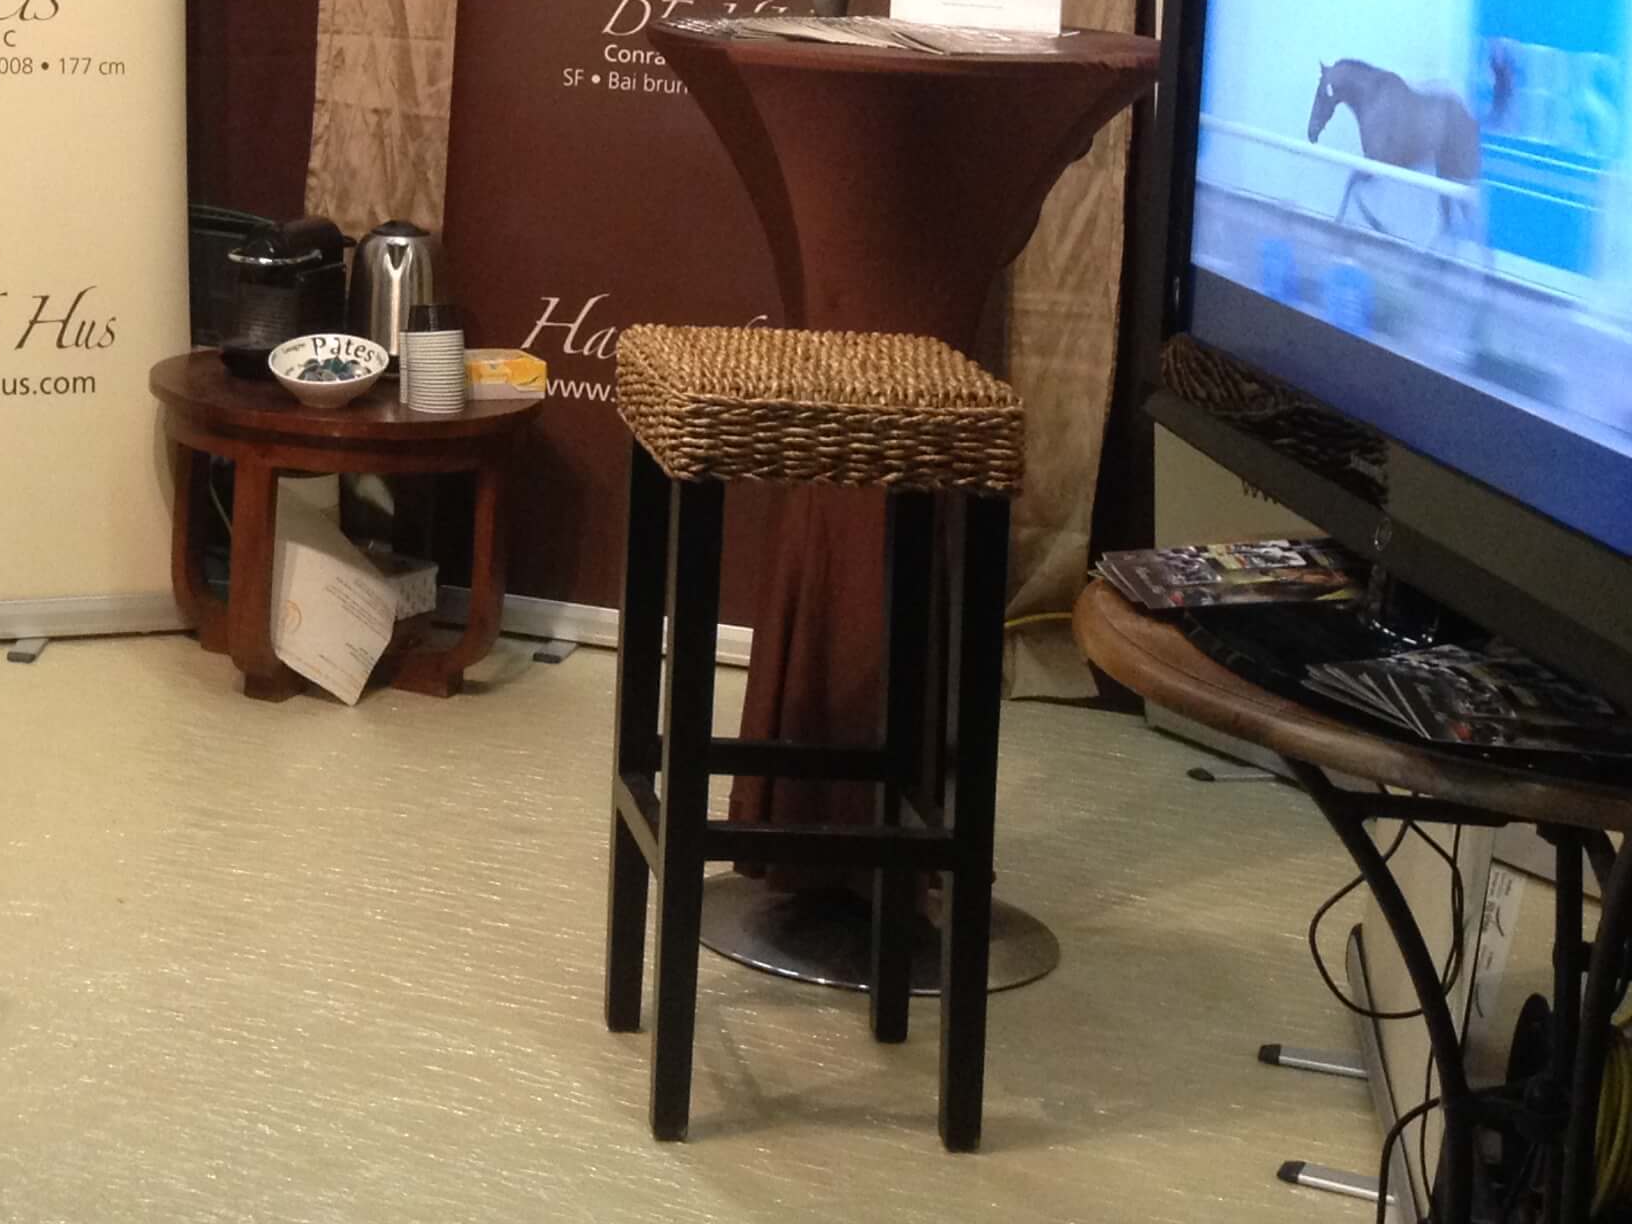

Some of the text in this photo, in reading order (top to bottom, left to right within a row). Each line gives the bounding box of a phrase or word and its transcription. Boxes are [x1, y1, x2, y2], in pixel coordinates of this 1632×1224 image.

[3, 30, 17, 48] C
[604, 44, 666, 65] Conra
[59, 57, 92, 75] 177
[98, 60, 126, 75] cm
[562, 68, 585, 87] SF
[608, 71, 637, 91] Bai
[15, 285, 117, 351] Hus
